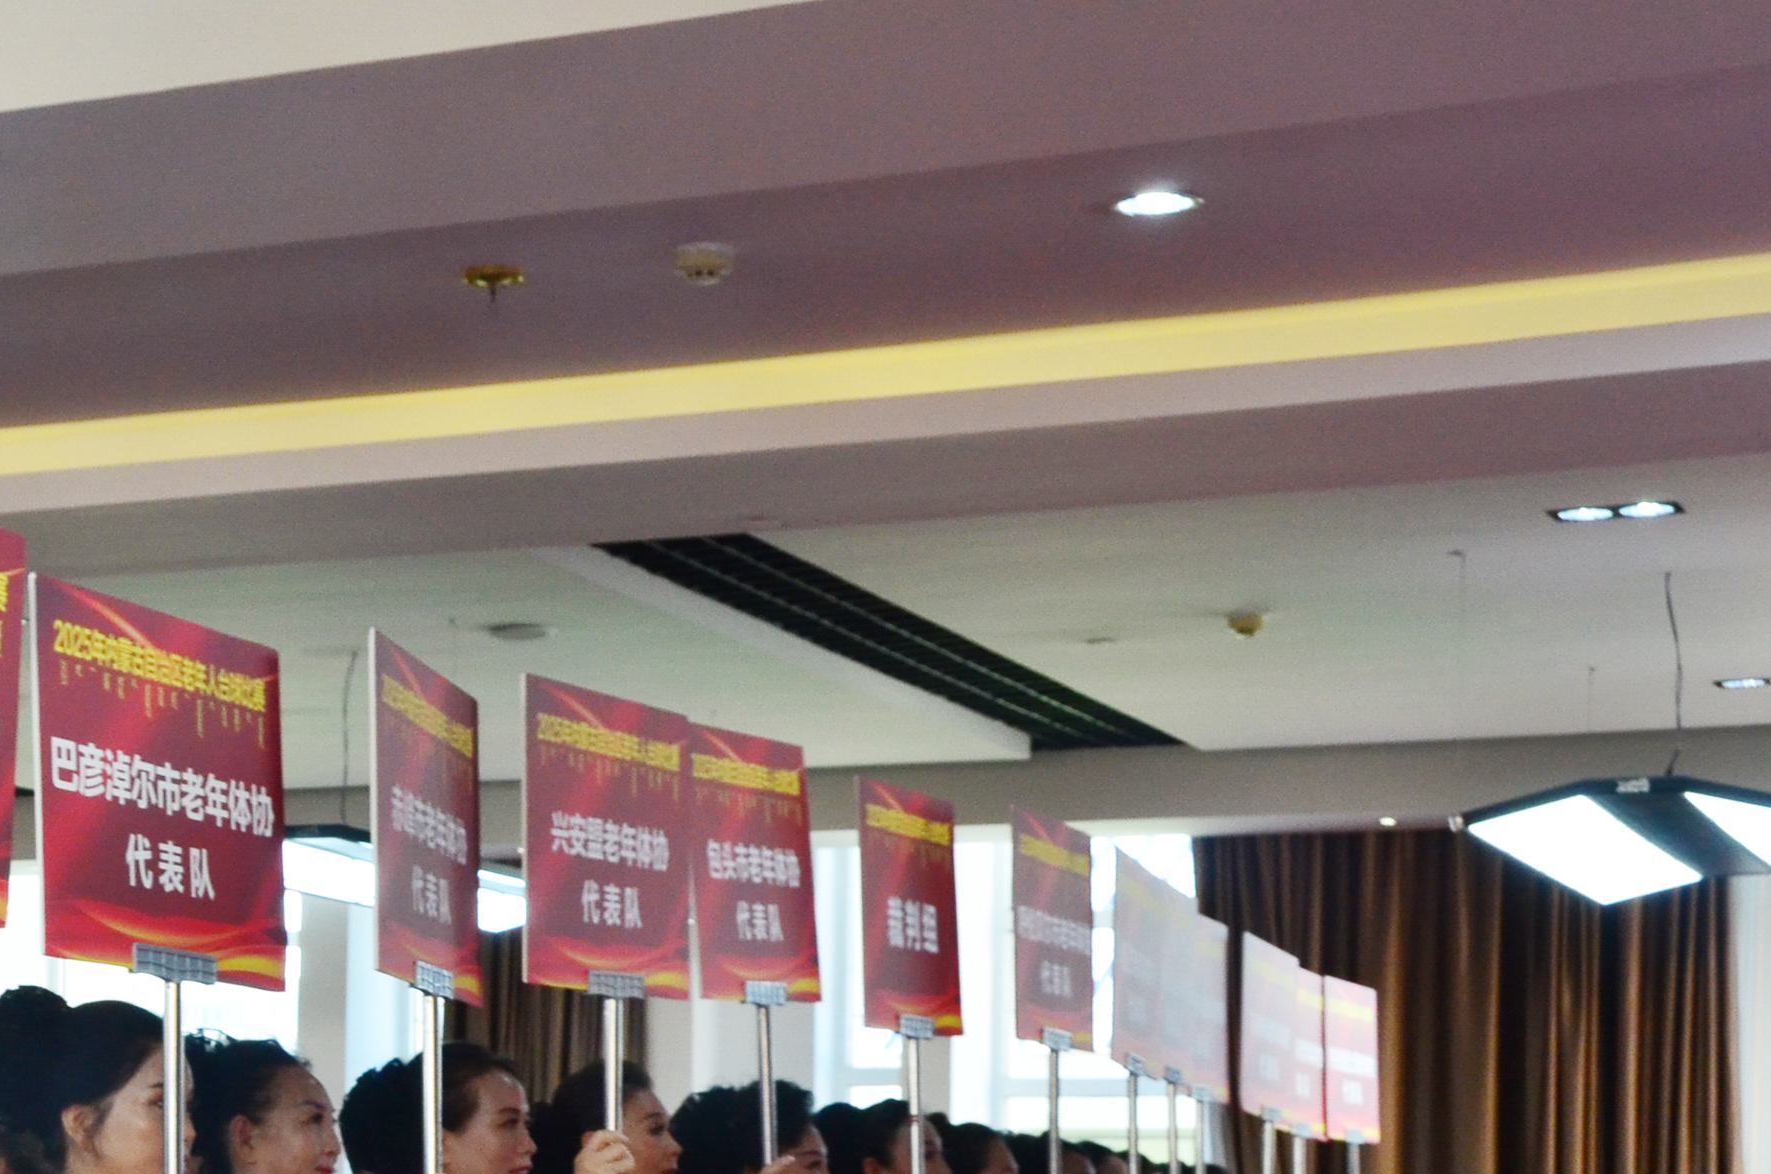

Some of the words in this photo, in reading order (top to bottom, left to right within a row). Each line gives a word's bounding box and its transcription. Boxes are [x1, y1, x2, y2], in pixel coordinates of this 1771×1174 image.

[51, 736, 274, 837] 巴彦淖尔市老年体协
[125, 833, 216, 901] 代表队
[550, 811, 669, 871] 兴安盟老年体协
[581, 879, 642, 928] 代表队
